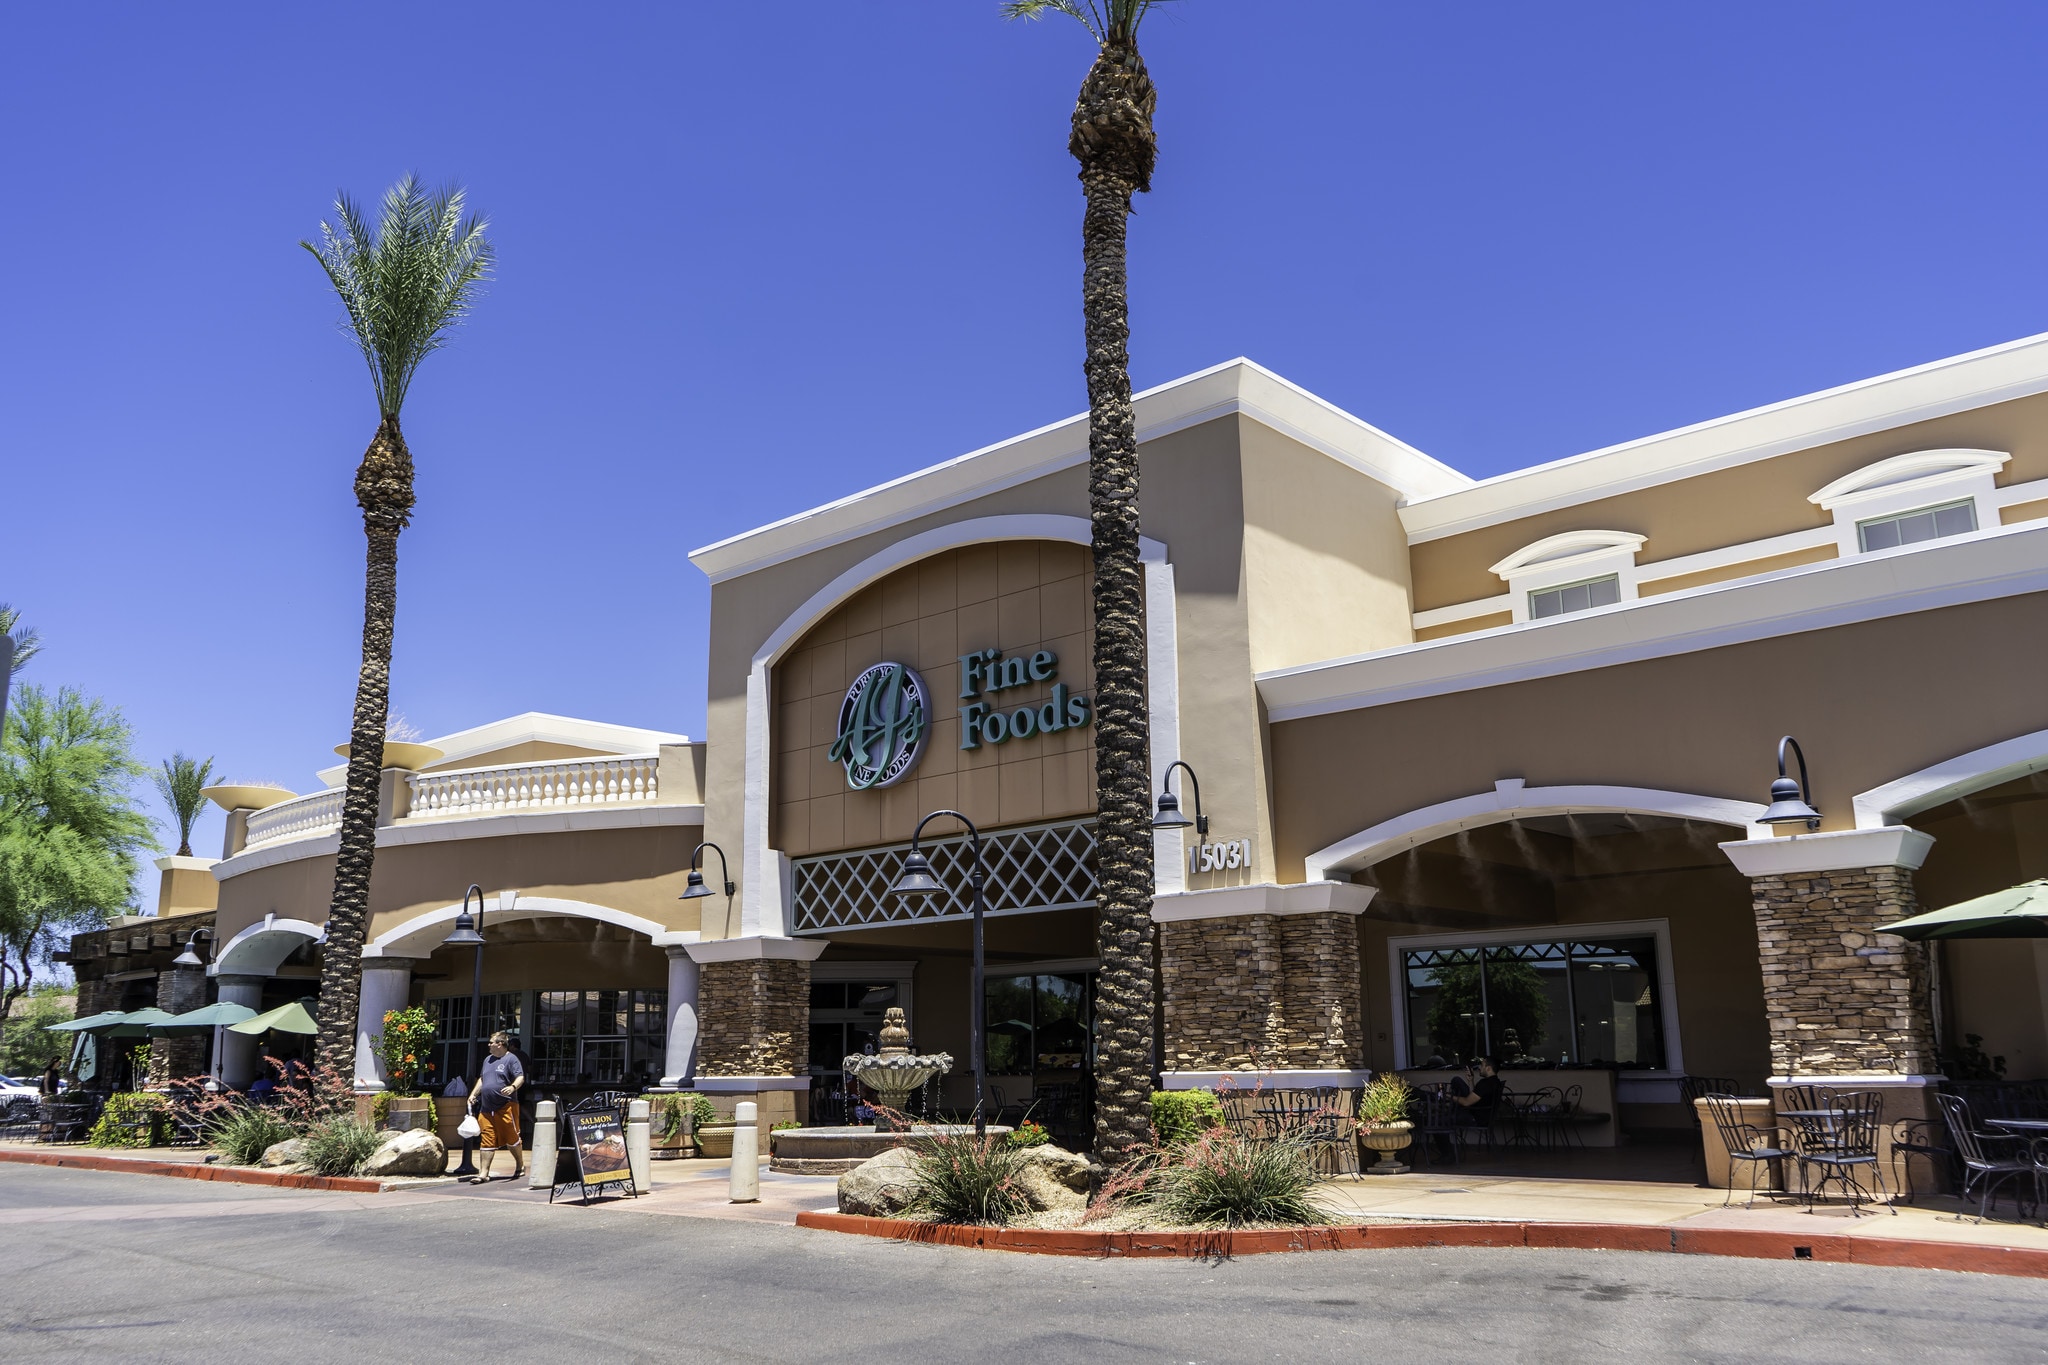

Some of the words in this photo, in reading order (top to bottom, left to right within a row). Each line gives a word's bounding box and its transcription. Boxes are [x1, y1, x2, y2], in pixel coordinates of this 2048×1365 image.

[849, 666, 893, 701] PURYO
[907, 684, 920, 701] OF
[958, 648, 1058, 699] Fine
[958, 682, 1092, 751] Foods
[854, 765, 872, 782] NE
[881, 750, 911, 781] OODS
[1187, 838, 1252, 874] 15031
[580, 1115, 612, 1125] SALMON
